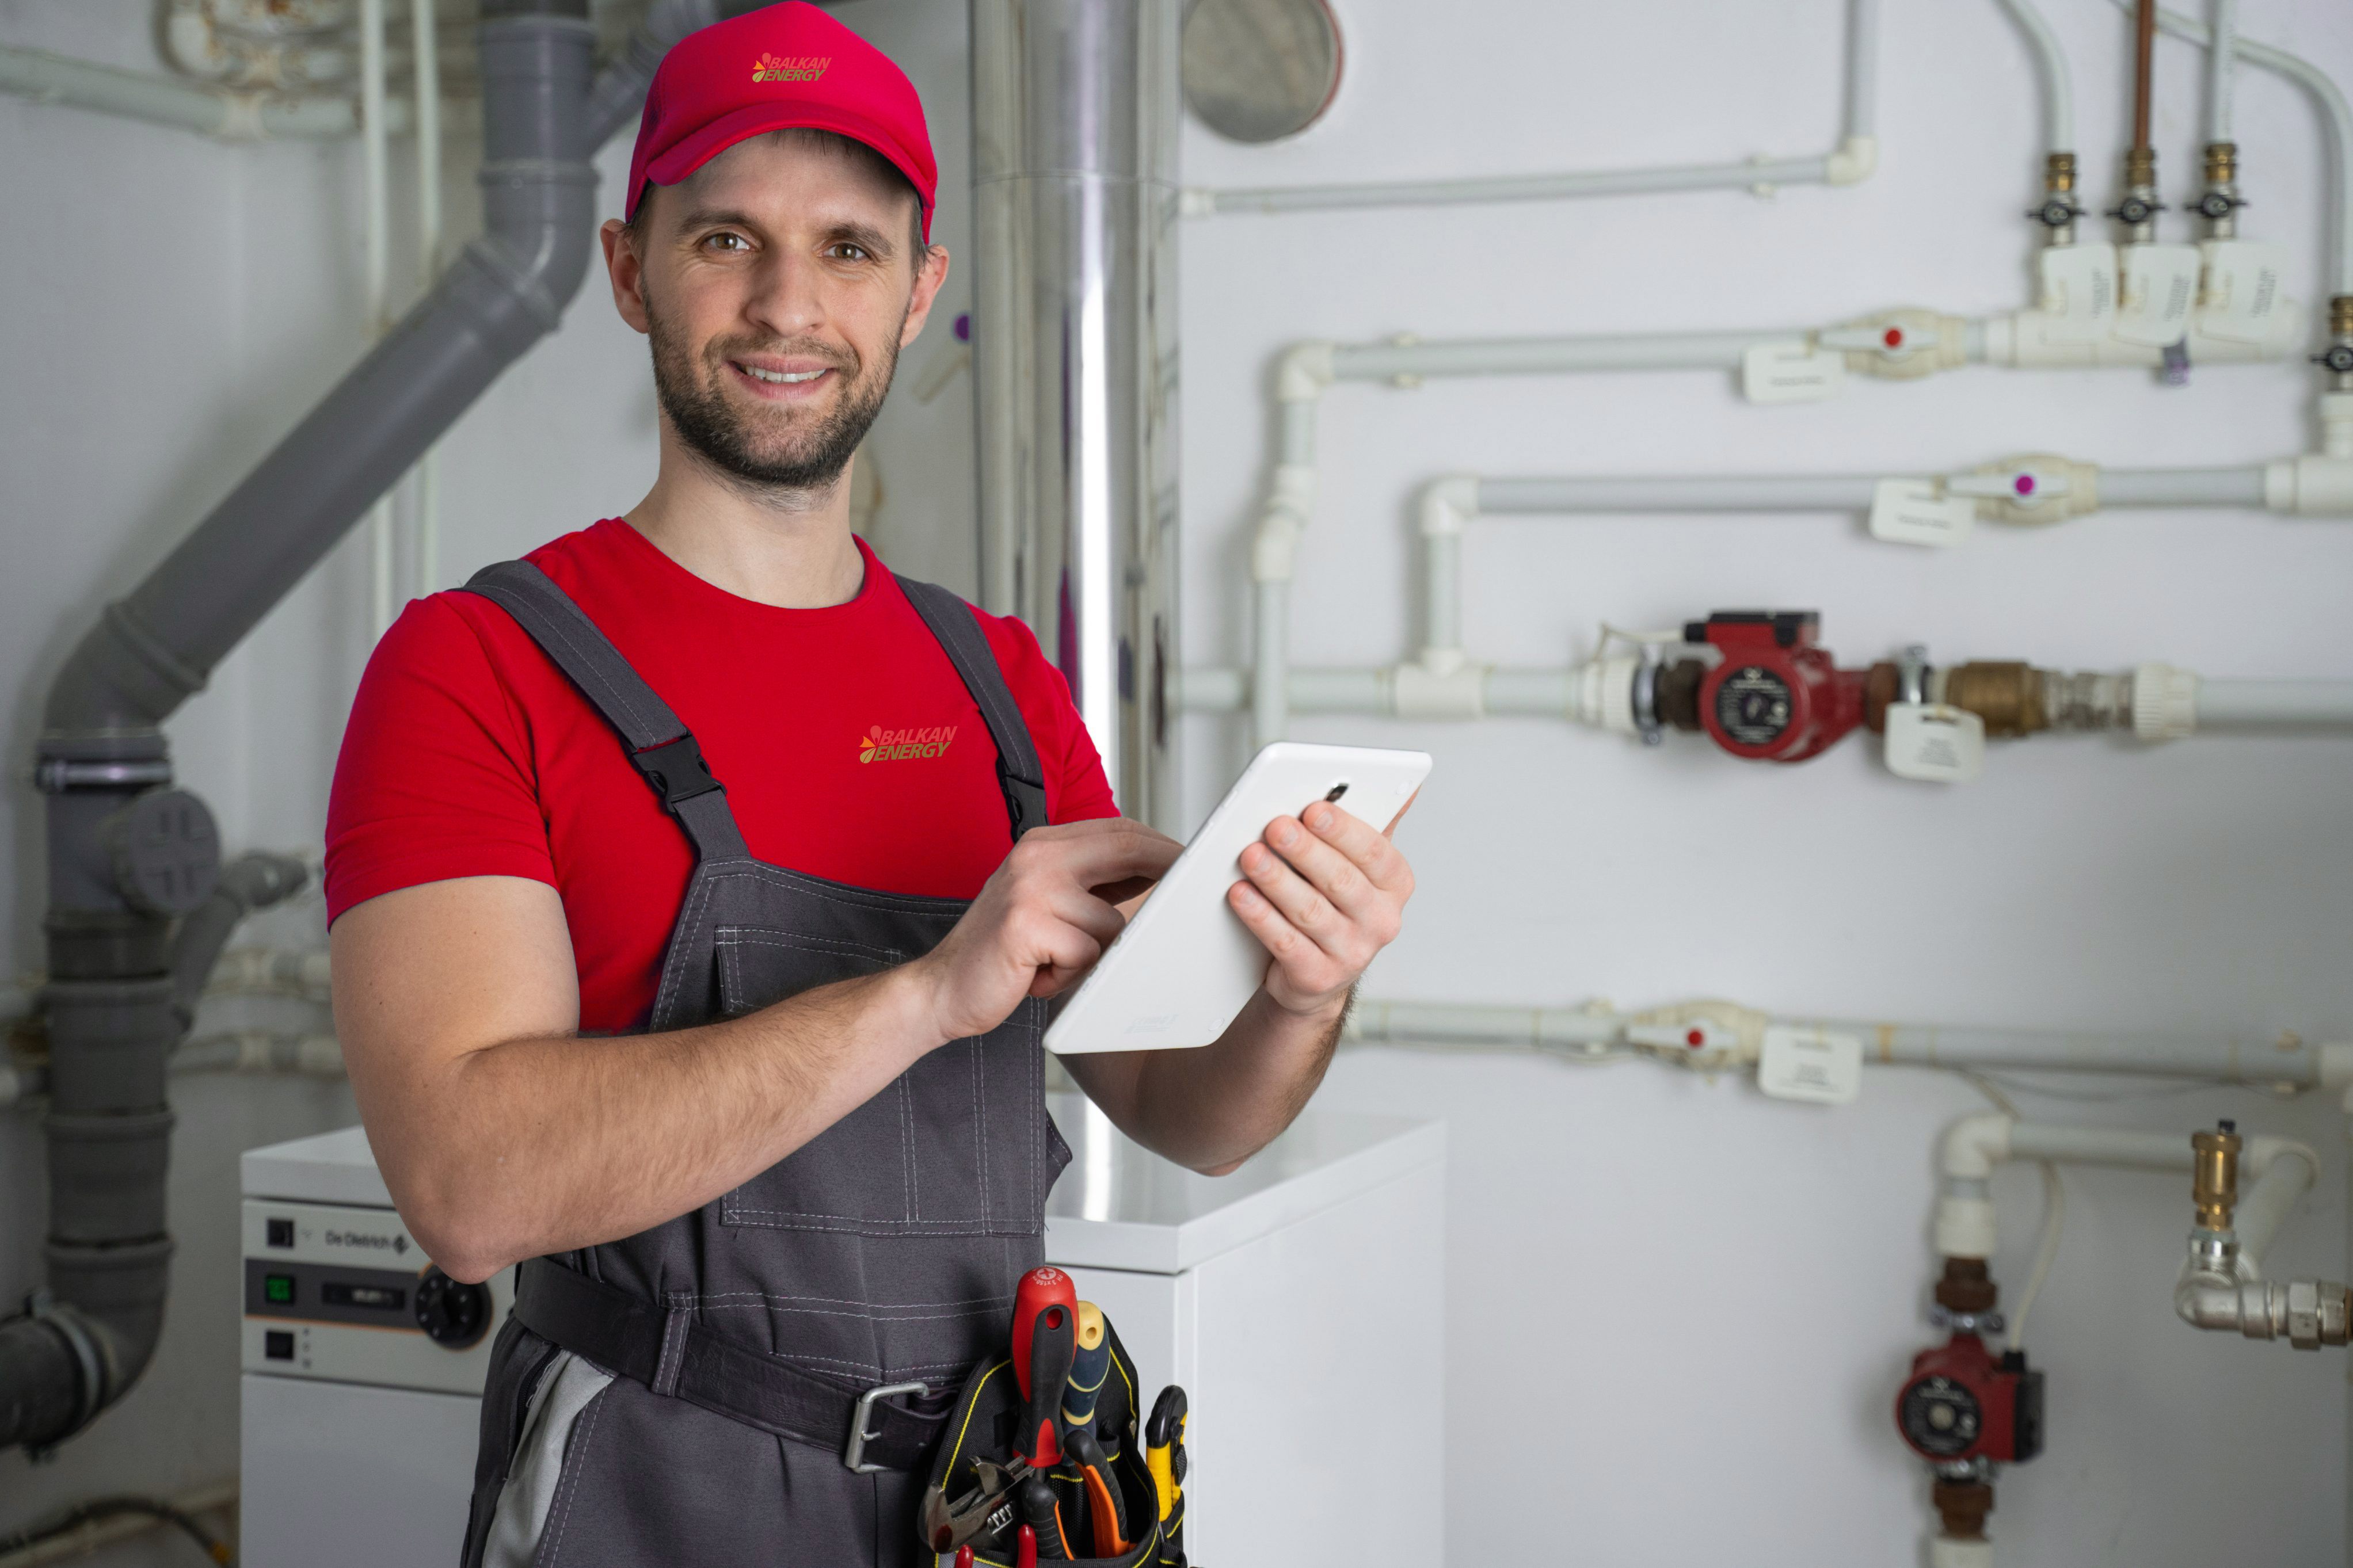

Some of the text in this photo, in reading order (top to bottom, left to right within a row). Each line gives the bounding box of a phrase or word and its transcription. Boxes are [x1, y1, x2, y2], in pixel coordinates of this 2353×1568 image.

[768, 57, 832, 70] BALKAN
[763, 69, 826, 82] ENERGY
[878, 726, 958, 746] BALKAN
[873, 741, 951, 762] ENERGY
[325, 1230, 342, 1247] De
